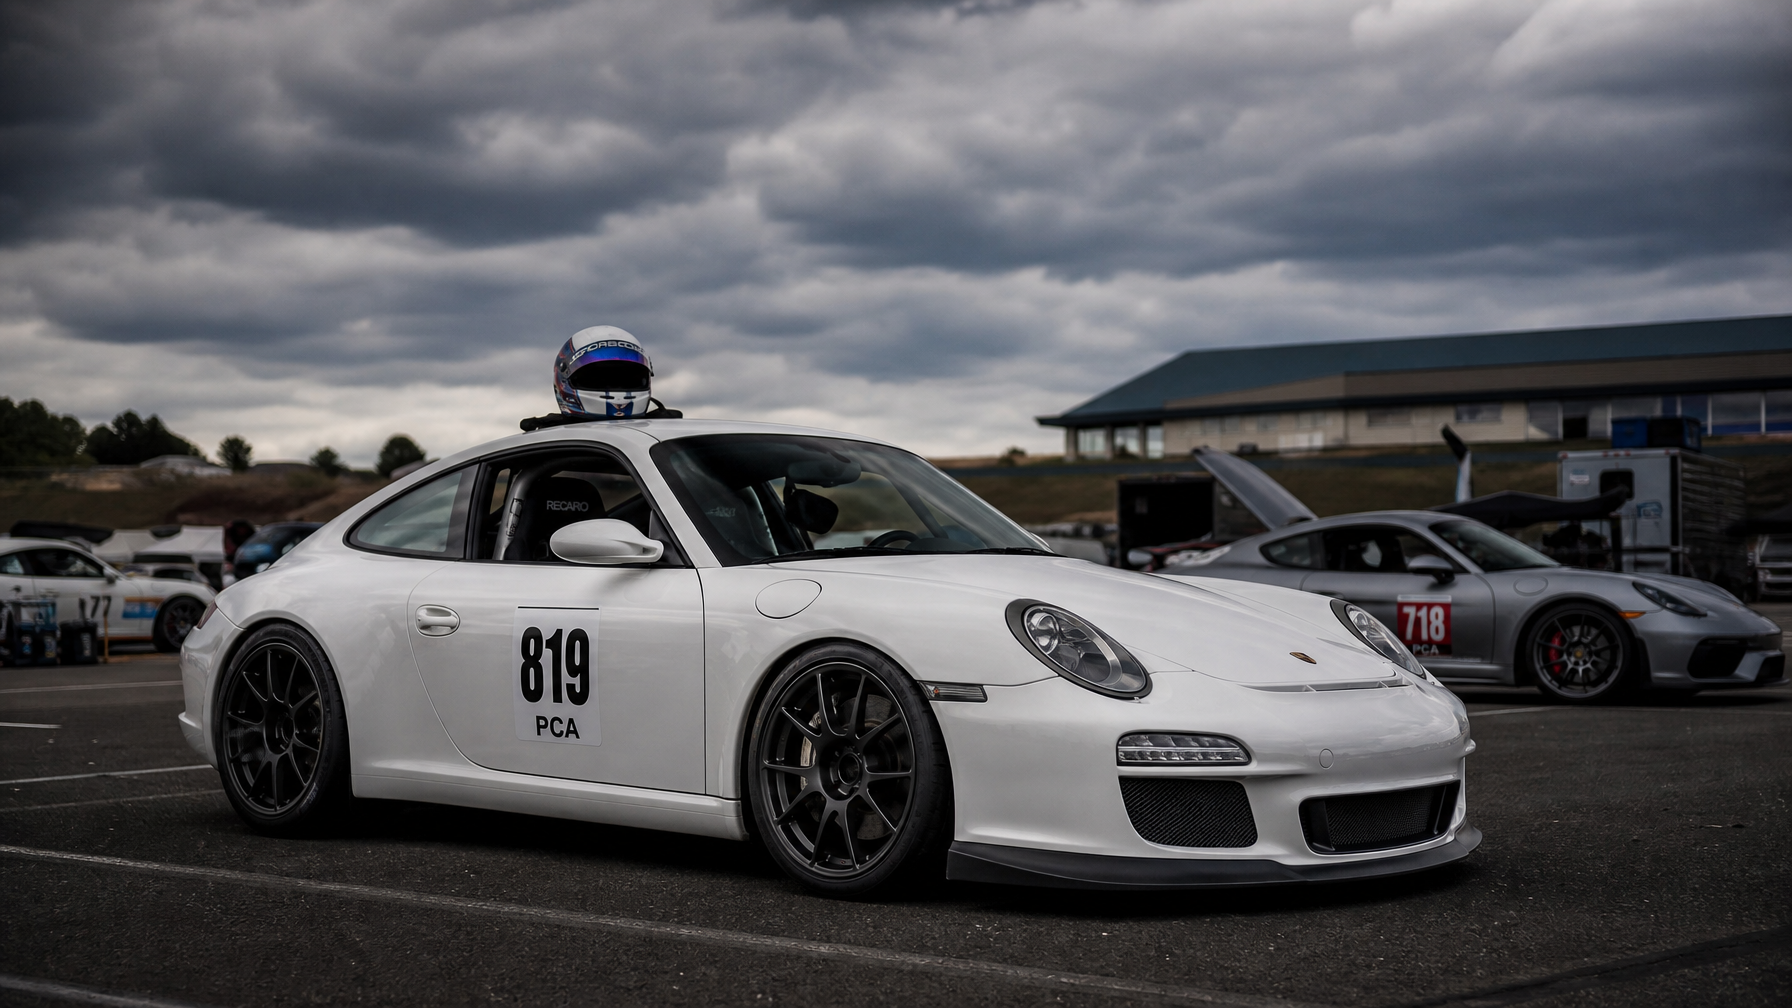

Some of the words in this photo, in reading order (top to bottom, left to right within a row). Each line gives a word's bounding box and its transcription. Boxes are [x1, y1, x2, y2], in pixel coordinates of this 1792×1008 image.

[546, 500, 589, 512] RECARO
[1402, 605, 1445, 642] 718
[1412, 643, 1440, 655] PCA
[521, 626, 590, 706] 819
[536, 715, 580, 739] PCA
